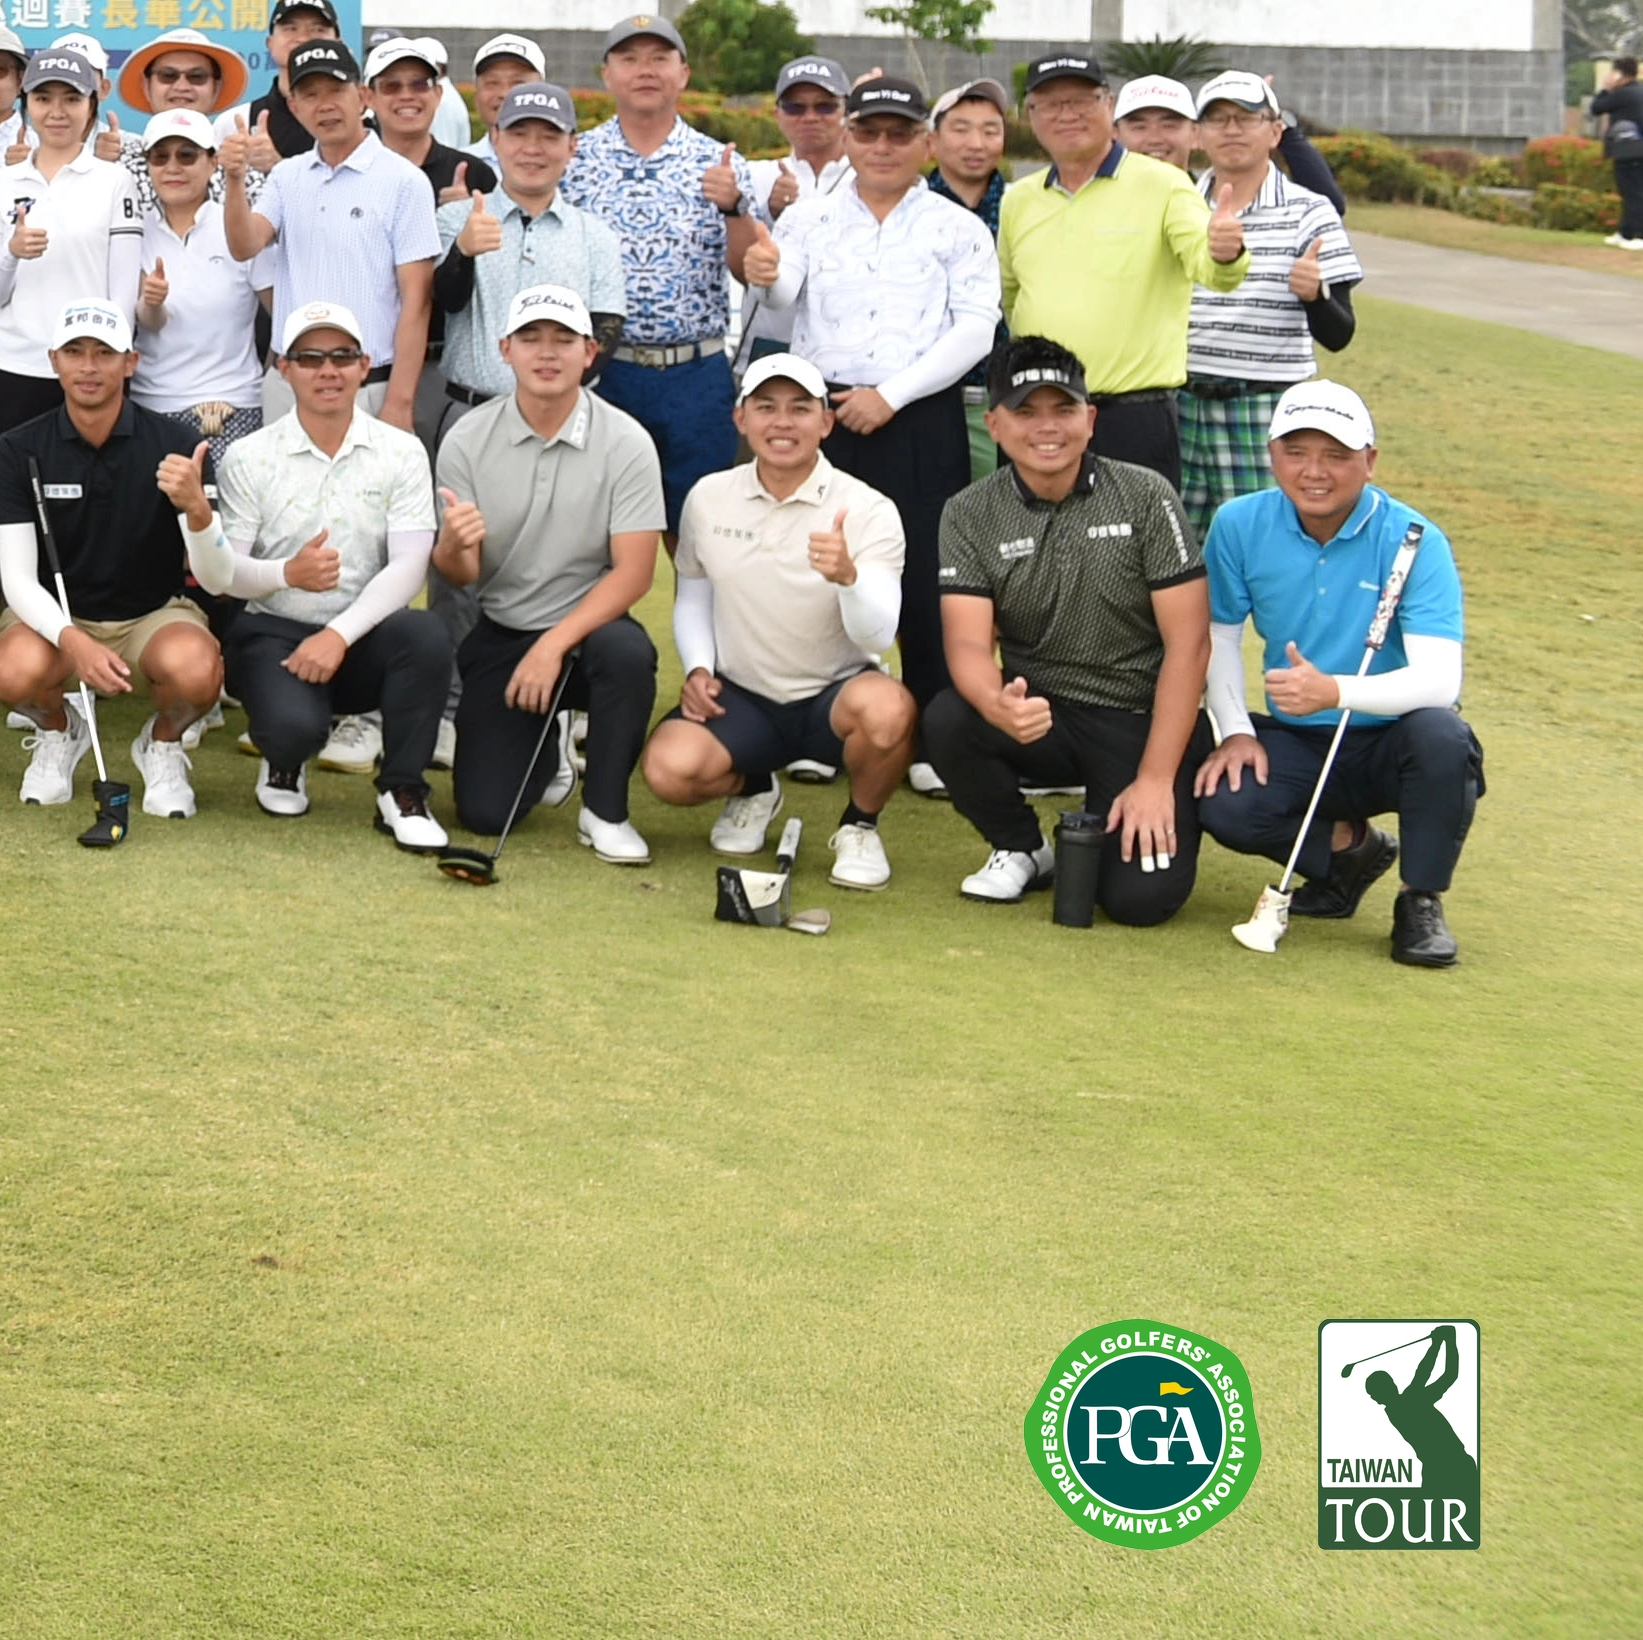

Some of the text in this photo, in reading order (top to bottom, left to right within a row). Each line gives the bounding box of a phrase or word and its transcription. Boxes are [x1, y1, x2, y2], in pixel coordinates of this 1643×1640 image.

[39, 57, 82, 73] TPGA
[295, 47, 340, 67] TPGA
[787, 63, 832, 79] TPGA
[515, 93, 560, 110] TPGA
[516, 293, 576, 316] Titleist
